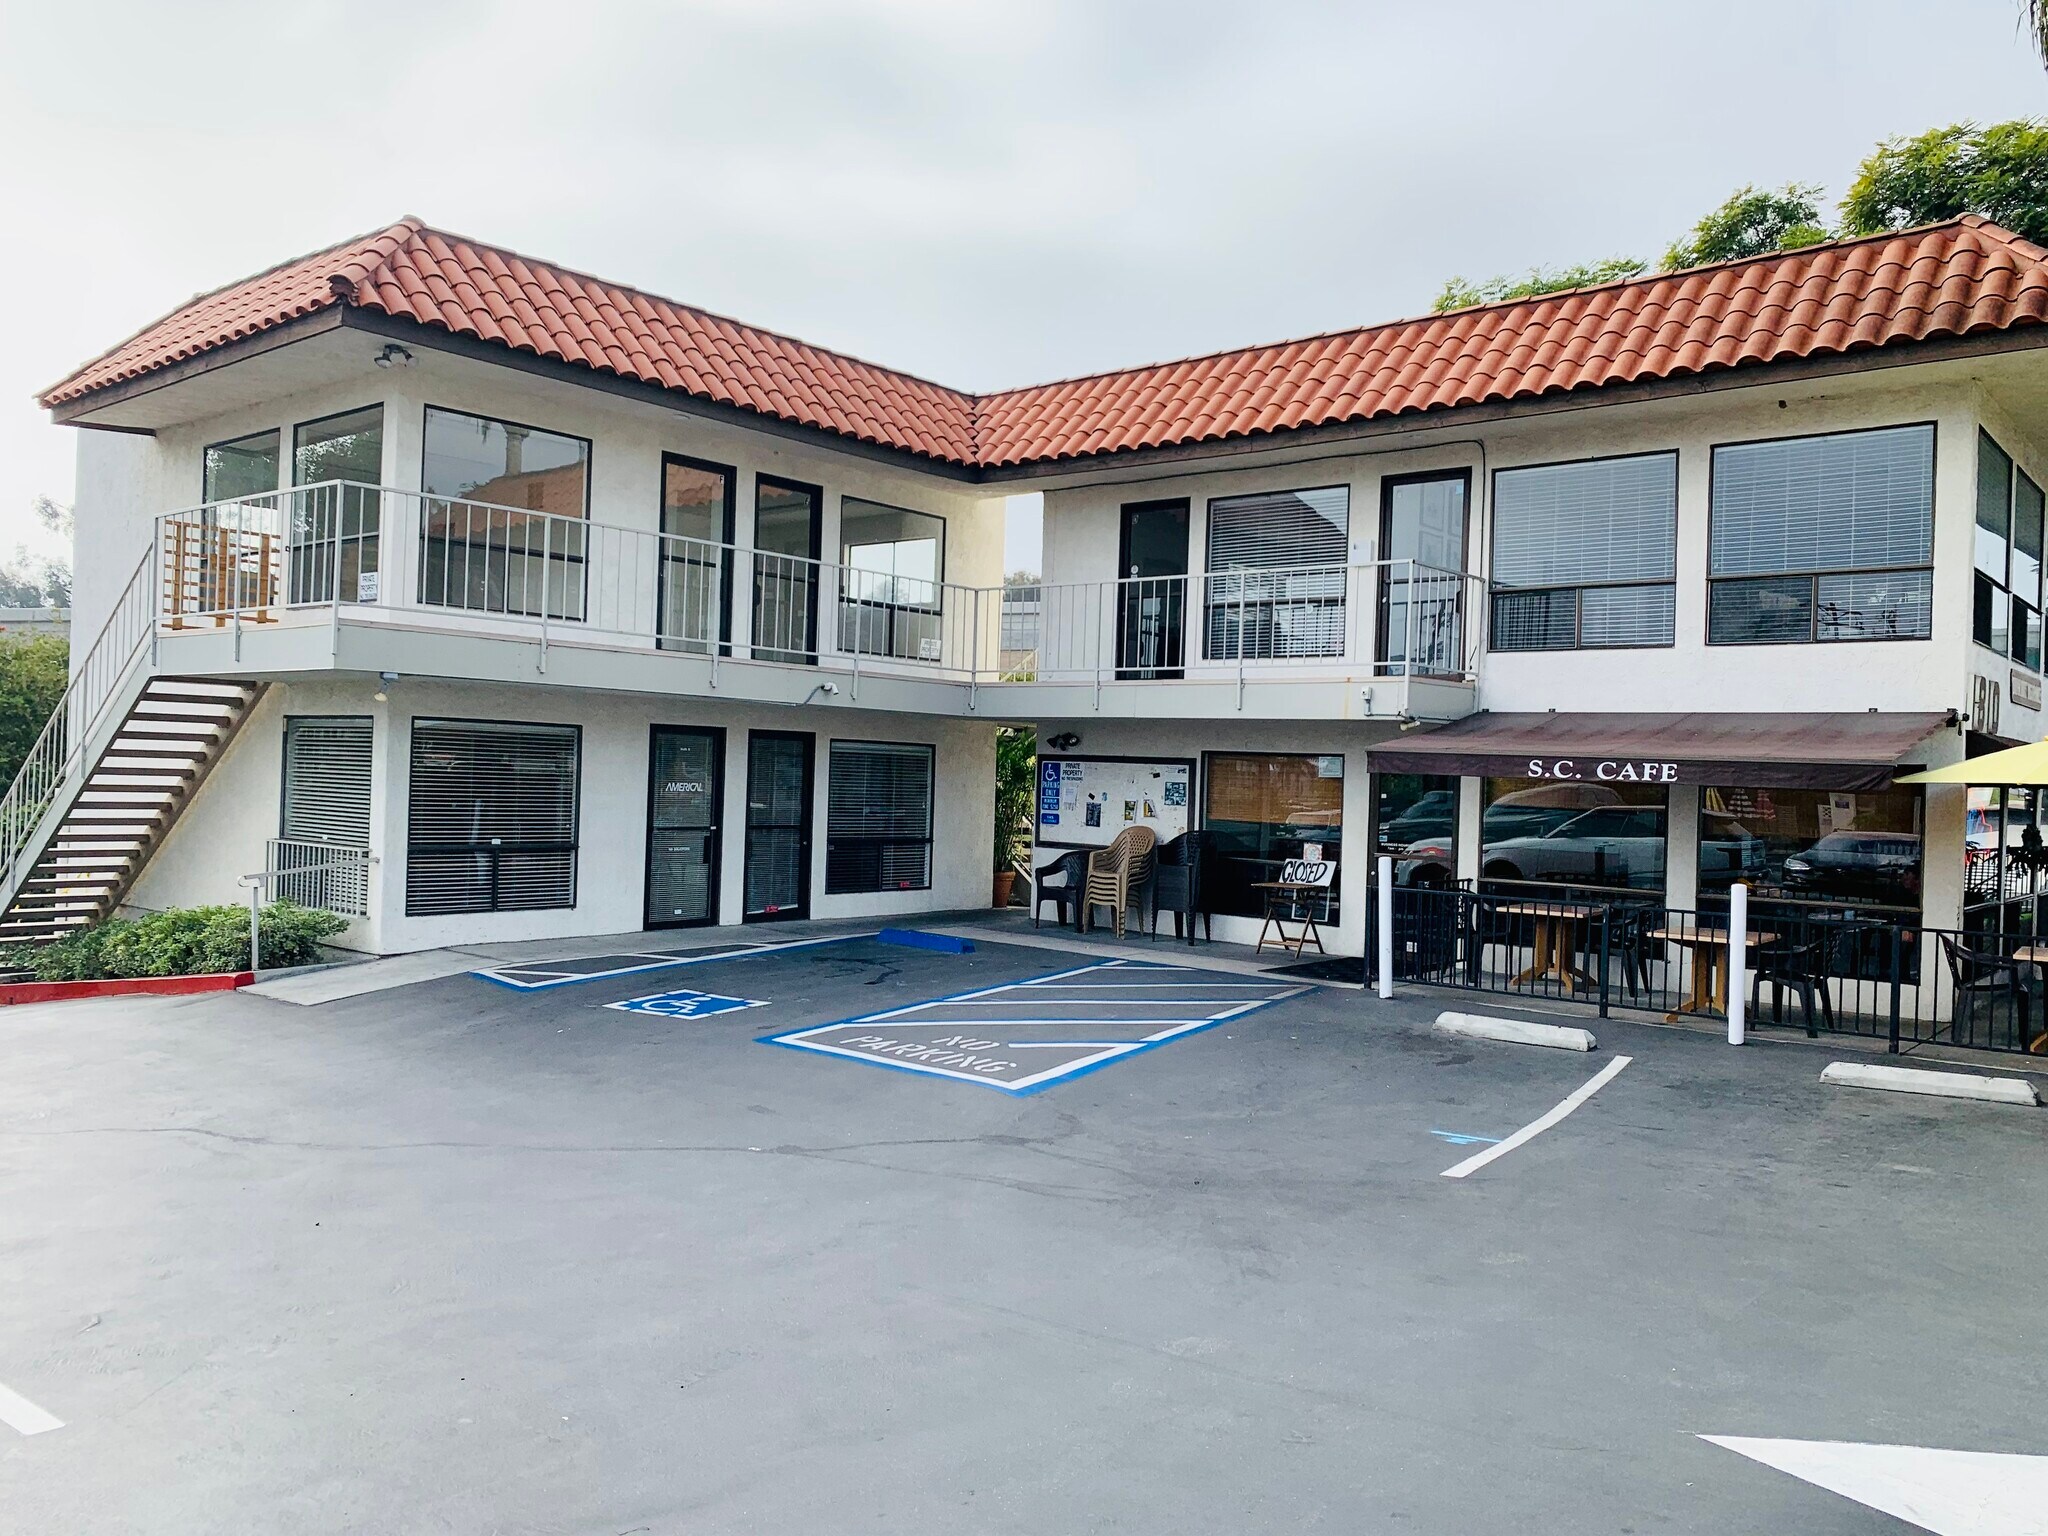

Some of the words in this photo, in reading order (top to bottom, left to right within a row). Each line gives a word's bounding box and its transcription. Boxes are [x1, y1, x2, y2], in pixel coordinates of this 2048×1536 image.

[1528, 759, 1582, 779] S.C.
[1596, 761, 1678, 782] CAFE
[665, 782, 704, 792] AMERICAL
[1282, 860, 1328, 883] CLOSED
[839, 1035, 1017, 1072] PARKING
[931, 1035, 1000, 1050] NO
